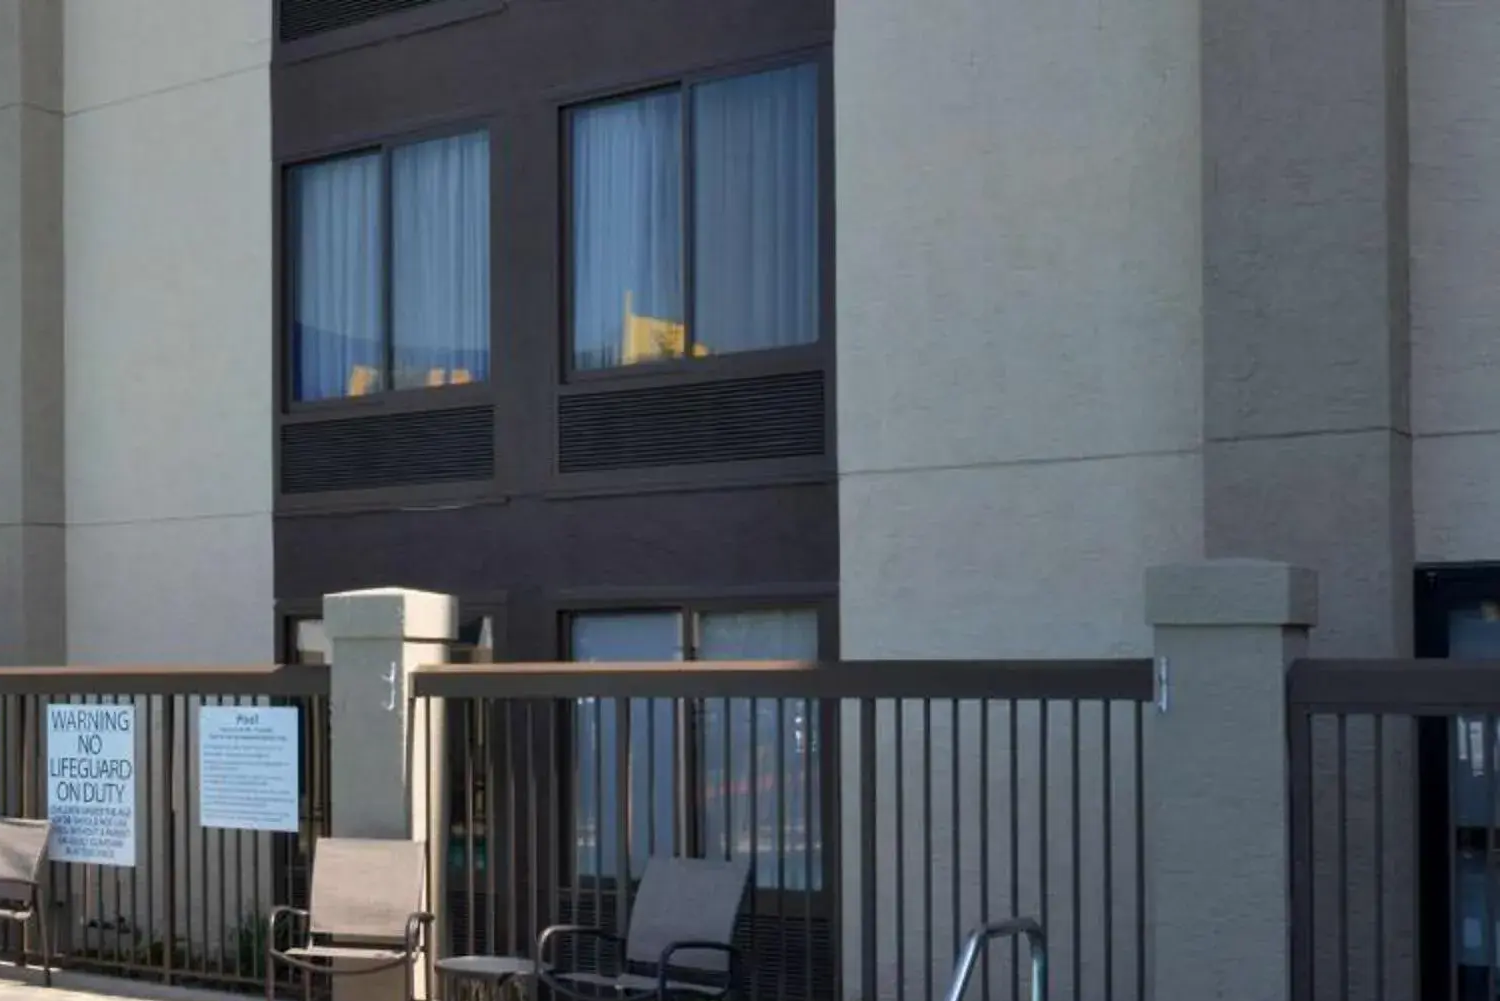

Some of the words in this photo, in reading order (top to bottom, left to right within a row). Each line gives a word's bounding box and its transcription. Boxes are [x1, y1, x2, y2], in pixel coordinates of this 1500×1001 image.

[51, 709, 130, 732] WARNING
[77, 734, 103, 755] NO
[50, 757, 133, 780] LIFEGUARD
[56, 781, 80, 802] ON
[83, 783, 125, 803] DUTY
